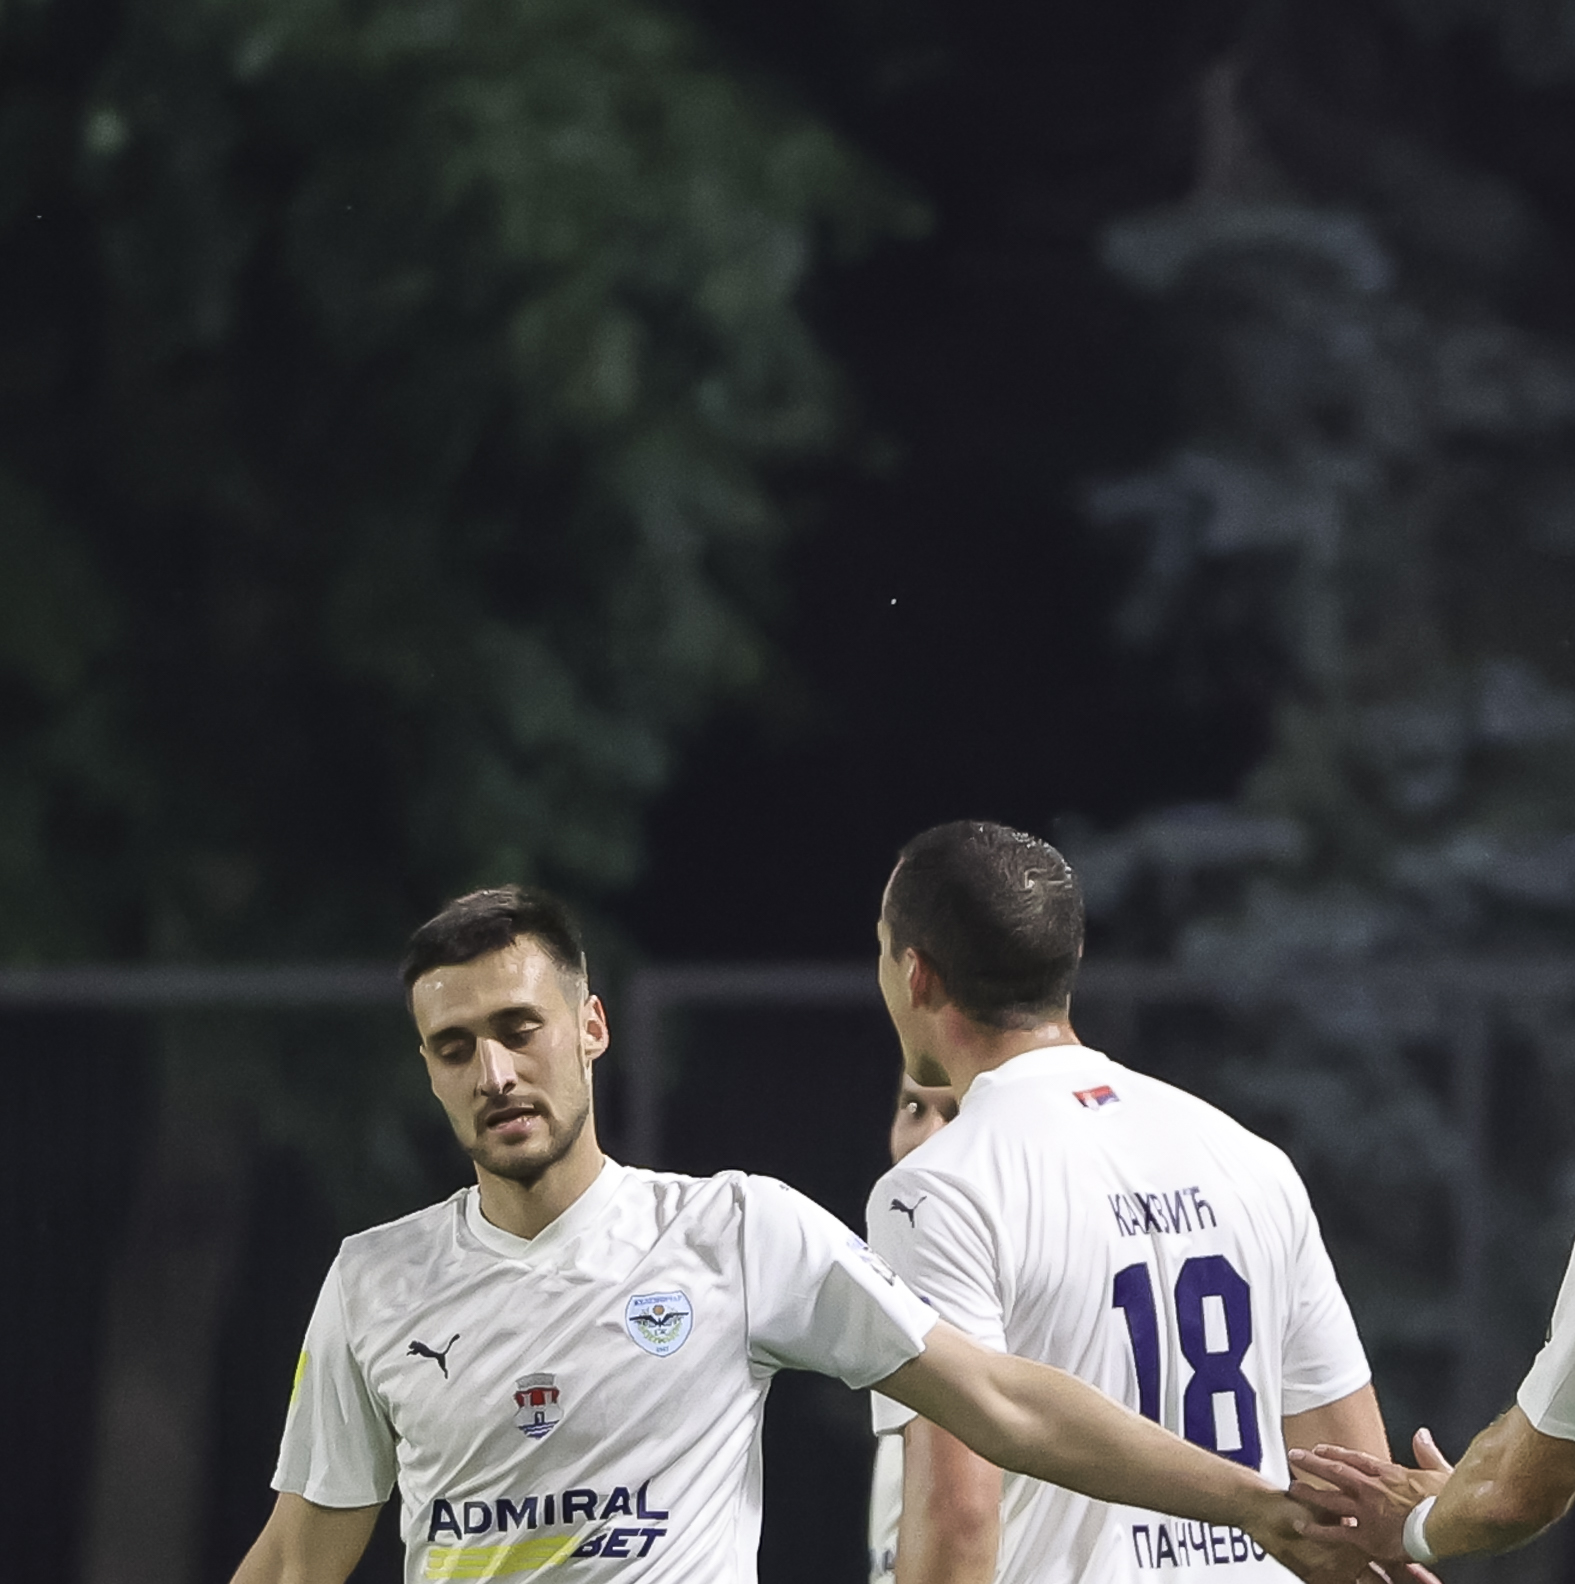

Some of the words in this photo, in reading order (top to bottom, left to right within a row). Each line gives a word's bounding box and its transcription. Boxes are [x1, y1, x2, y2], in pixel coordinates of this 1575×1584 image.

[1112, 1254, 1264, 1471] 18
[428, 1479, 669, 1542] ADMIRAL
[570, 1528, 668, 1558] BET
